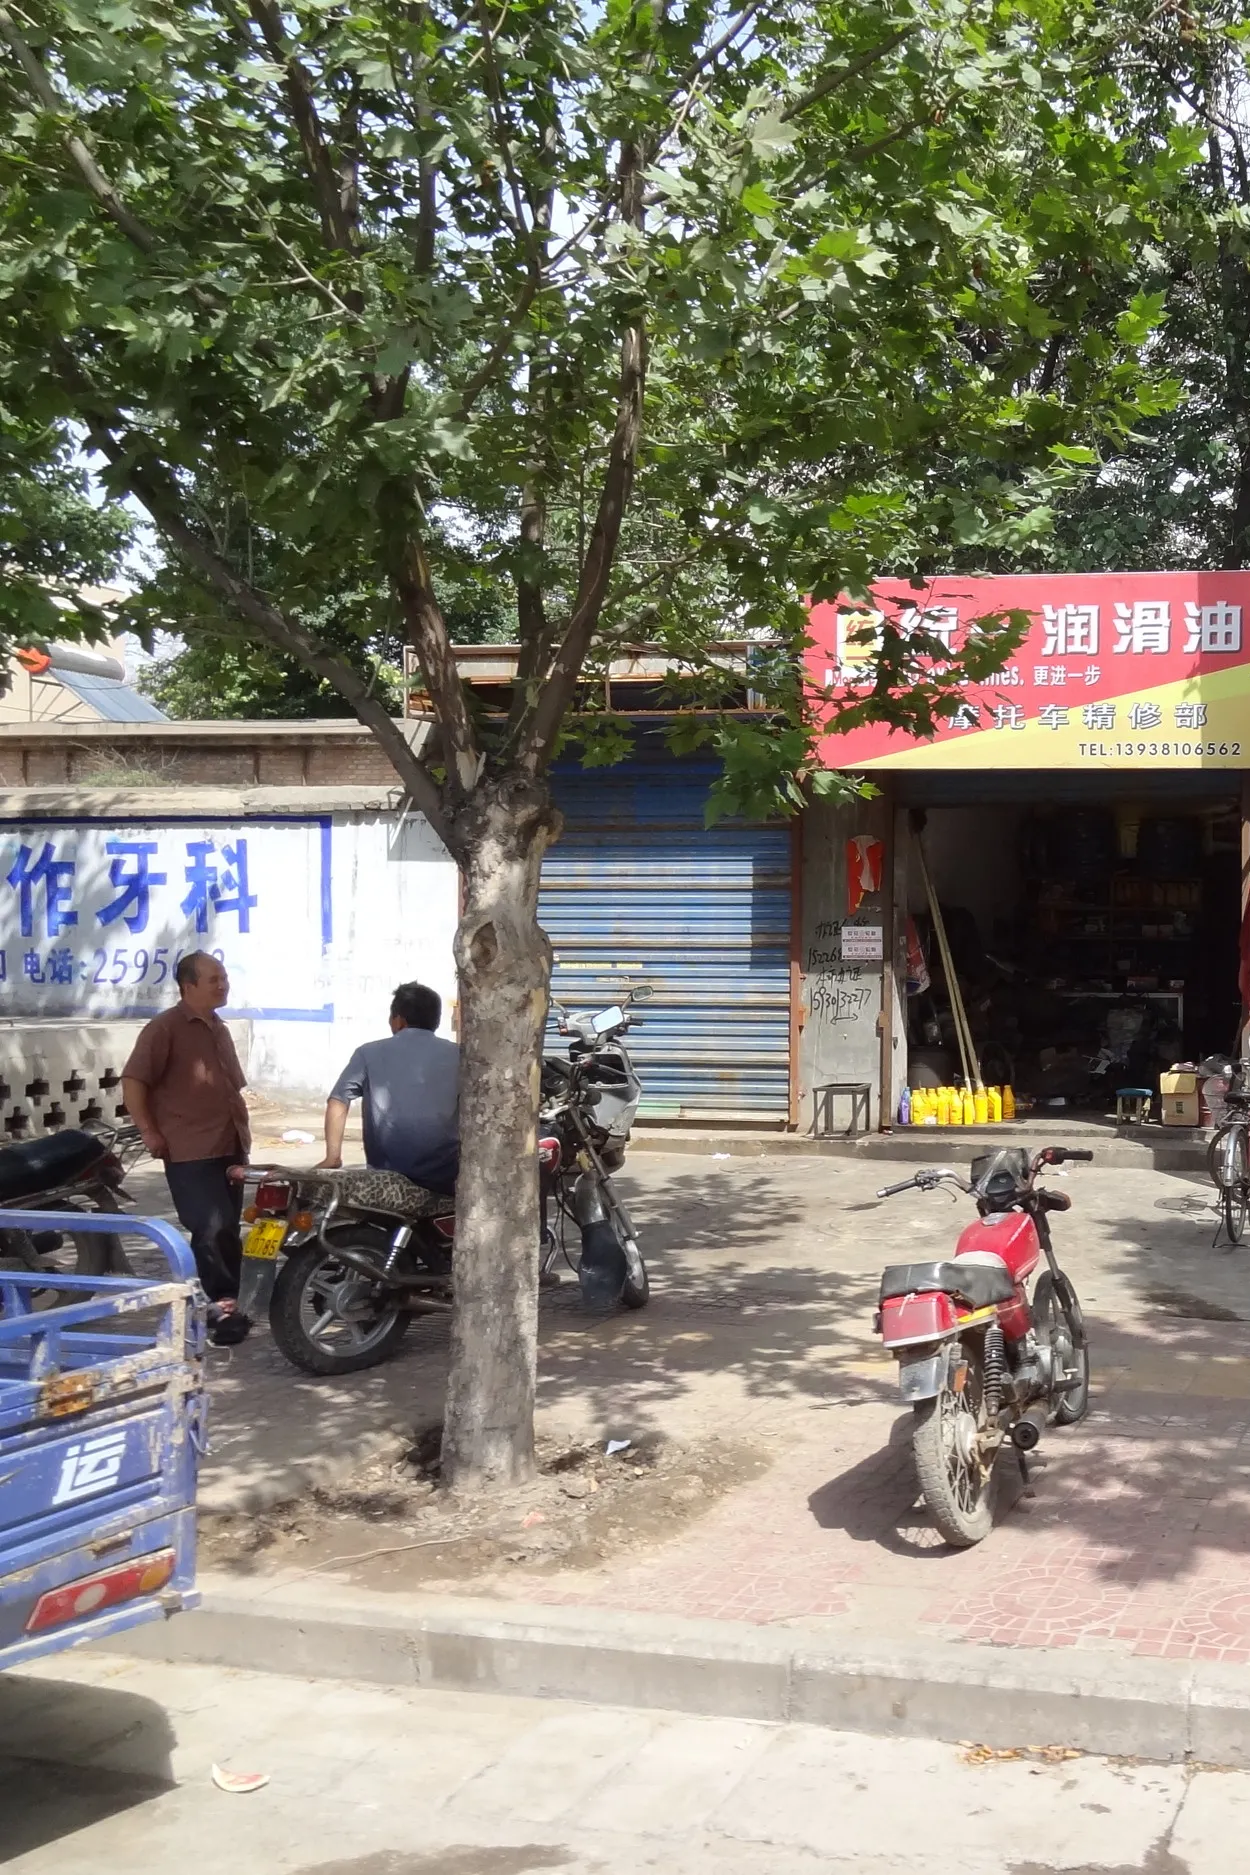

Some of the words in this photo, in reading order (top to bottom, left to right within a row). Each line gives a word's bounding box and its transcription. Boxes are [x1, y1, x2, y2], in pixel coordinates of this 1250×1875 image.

[1033, 665, 1101, 687] 更进一步
[947, 702, 1208, 730] 摩托车精修部
[1078, 742, 1241, 757] TEL:13938106562
[6, 838, 258, 938] 作牙科
[52, 1430, 127, 1505] 运
